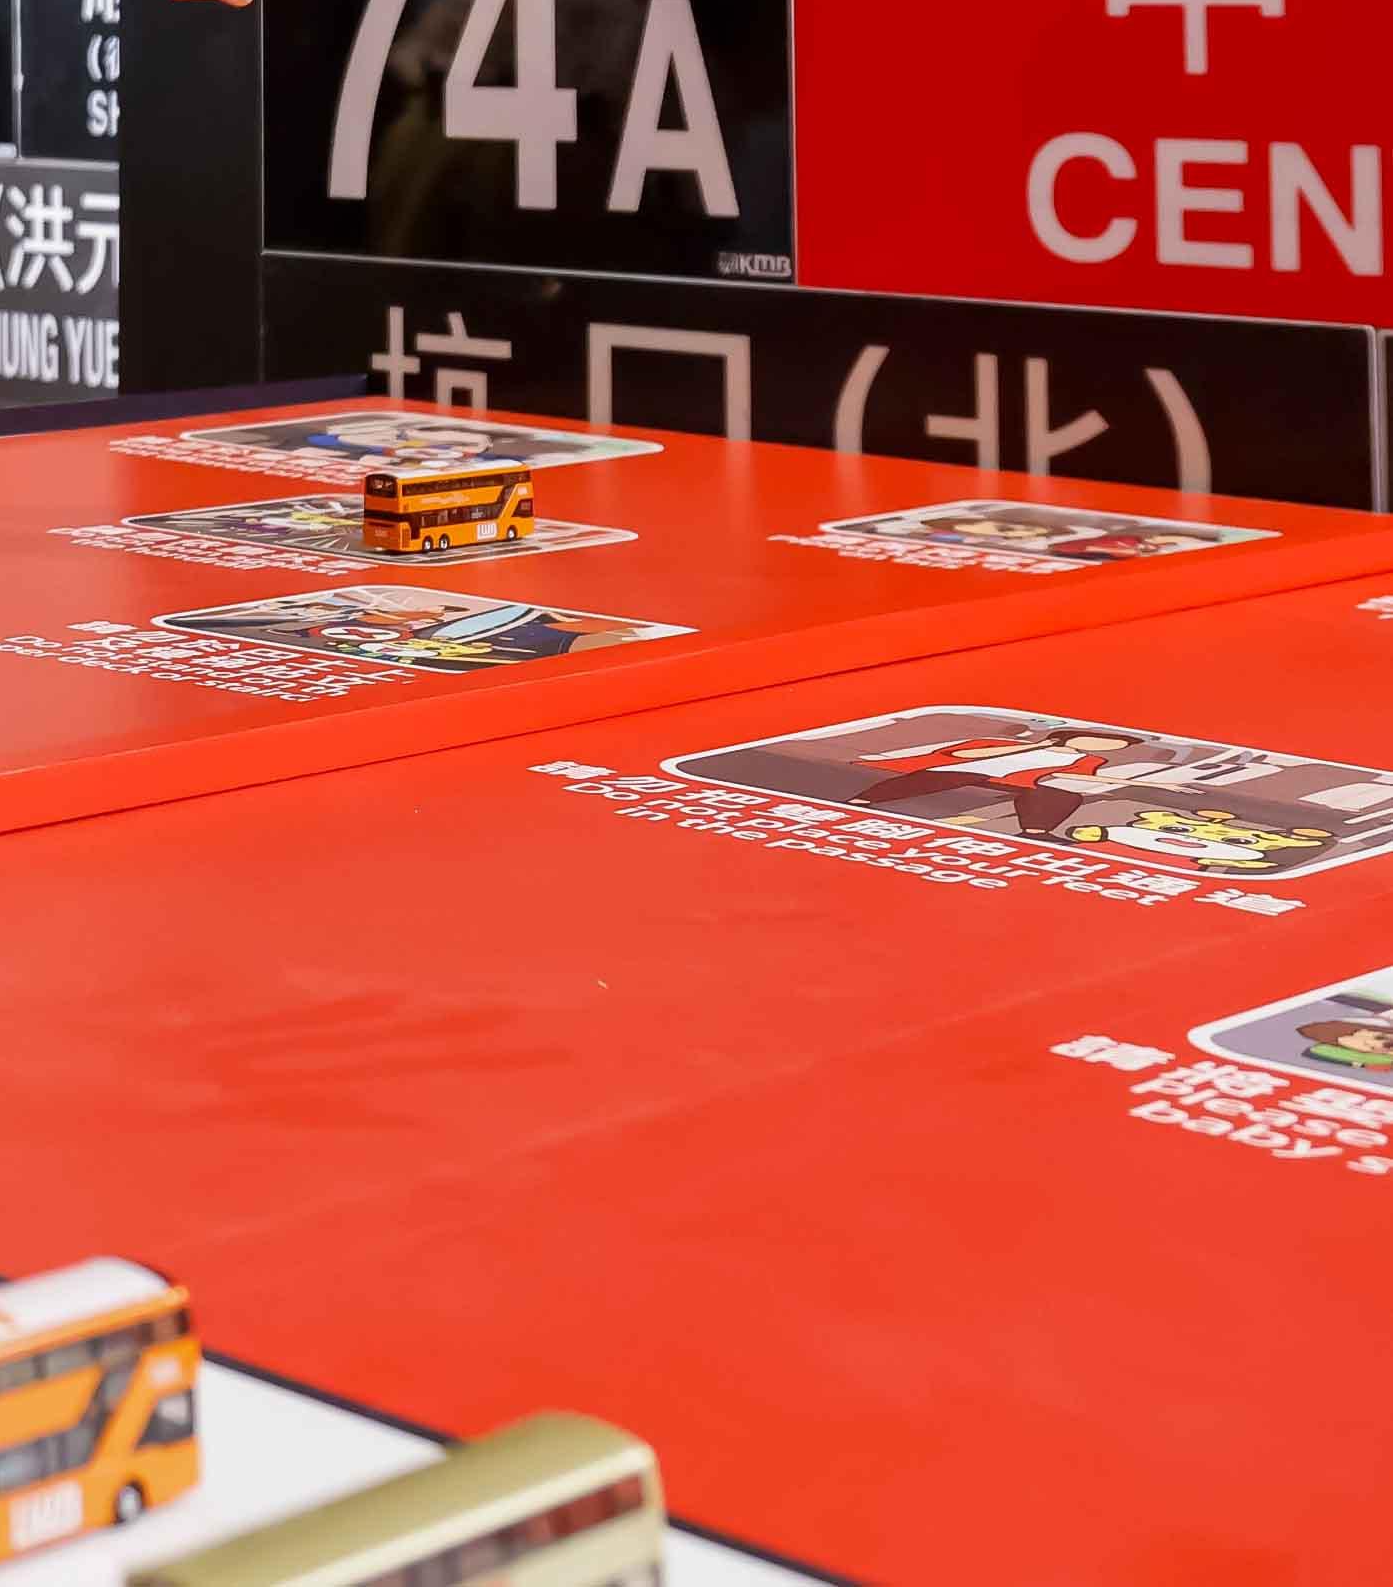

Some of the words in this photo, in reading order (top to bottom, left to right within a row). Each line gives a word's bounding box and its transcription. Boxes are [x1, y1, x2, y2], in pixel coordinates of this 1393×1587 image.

[1026, 131, 1385, 278] CEN
[4, 634, 64, 649] Do
[126, 656, 242, 680] stand
[240, 675, 300, 689] on
[54, 654, 154, 675] deck
[561, 781, 641, 802] Do
[644, 796, 743, 823] not
[743, 816, 892, 853] place
[887, 845, 1042, 880] your
[1040, 872, 1171, 907] feet
[615, 804, 671, 823] in
[675, 817, 769, 843] the
[764, 835, 1010, 891] passage
[1128, 1100, 1345, 1160] baby
[1129, 1074, 1390, 1148] Please
